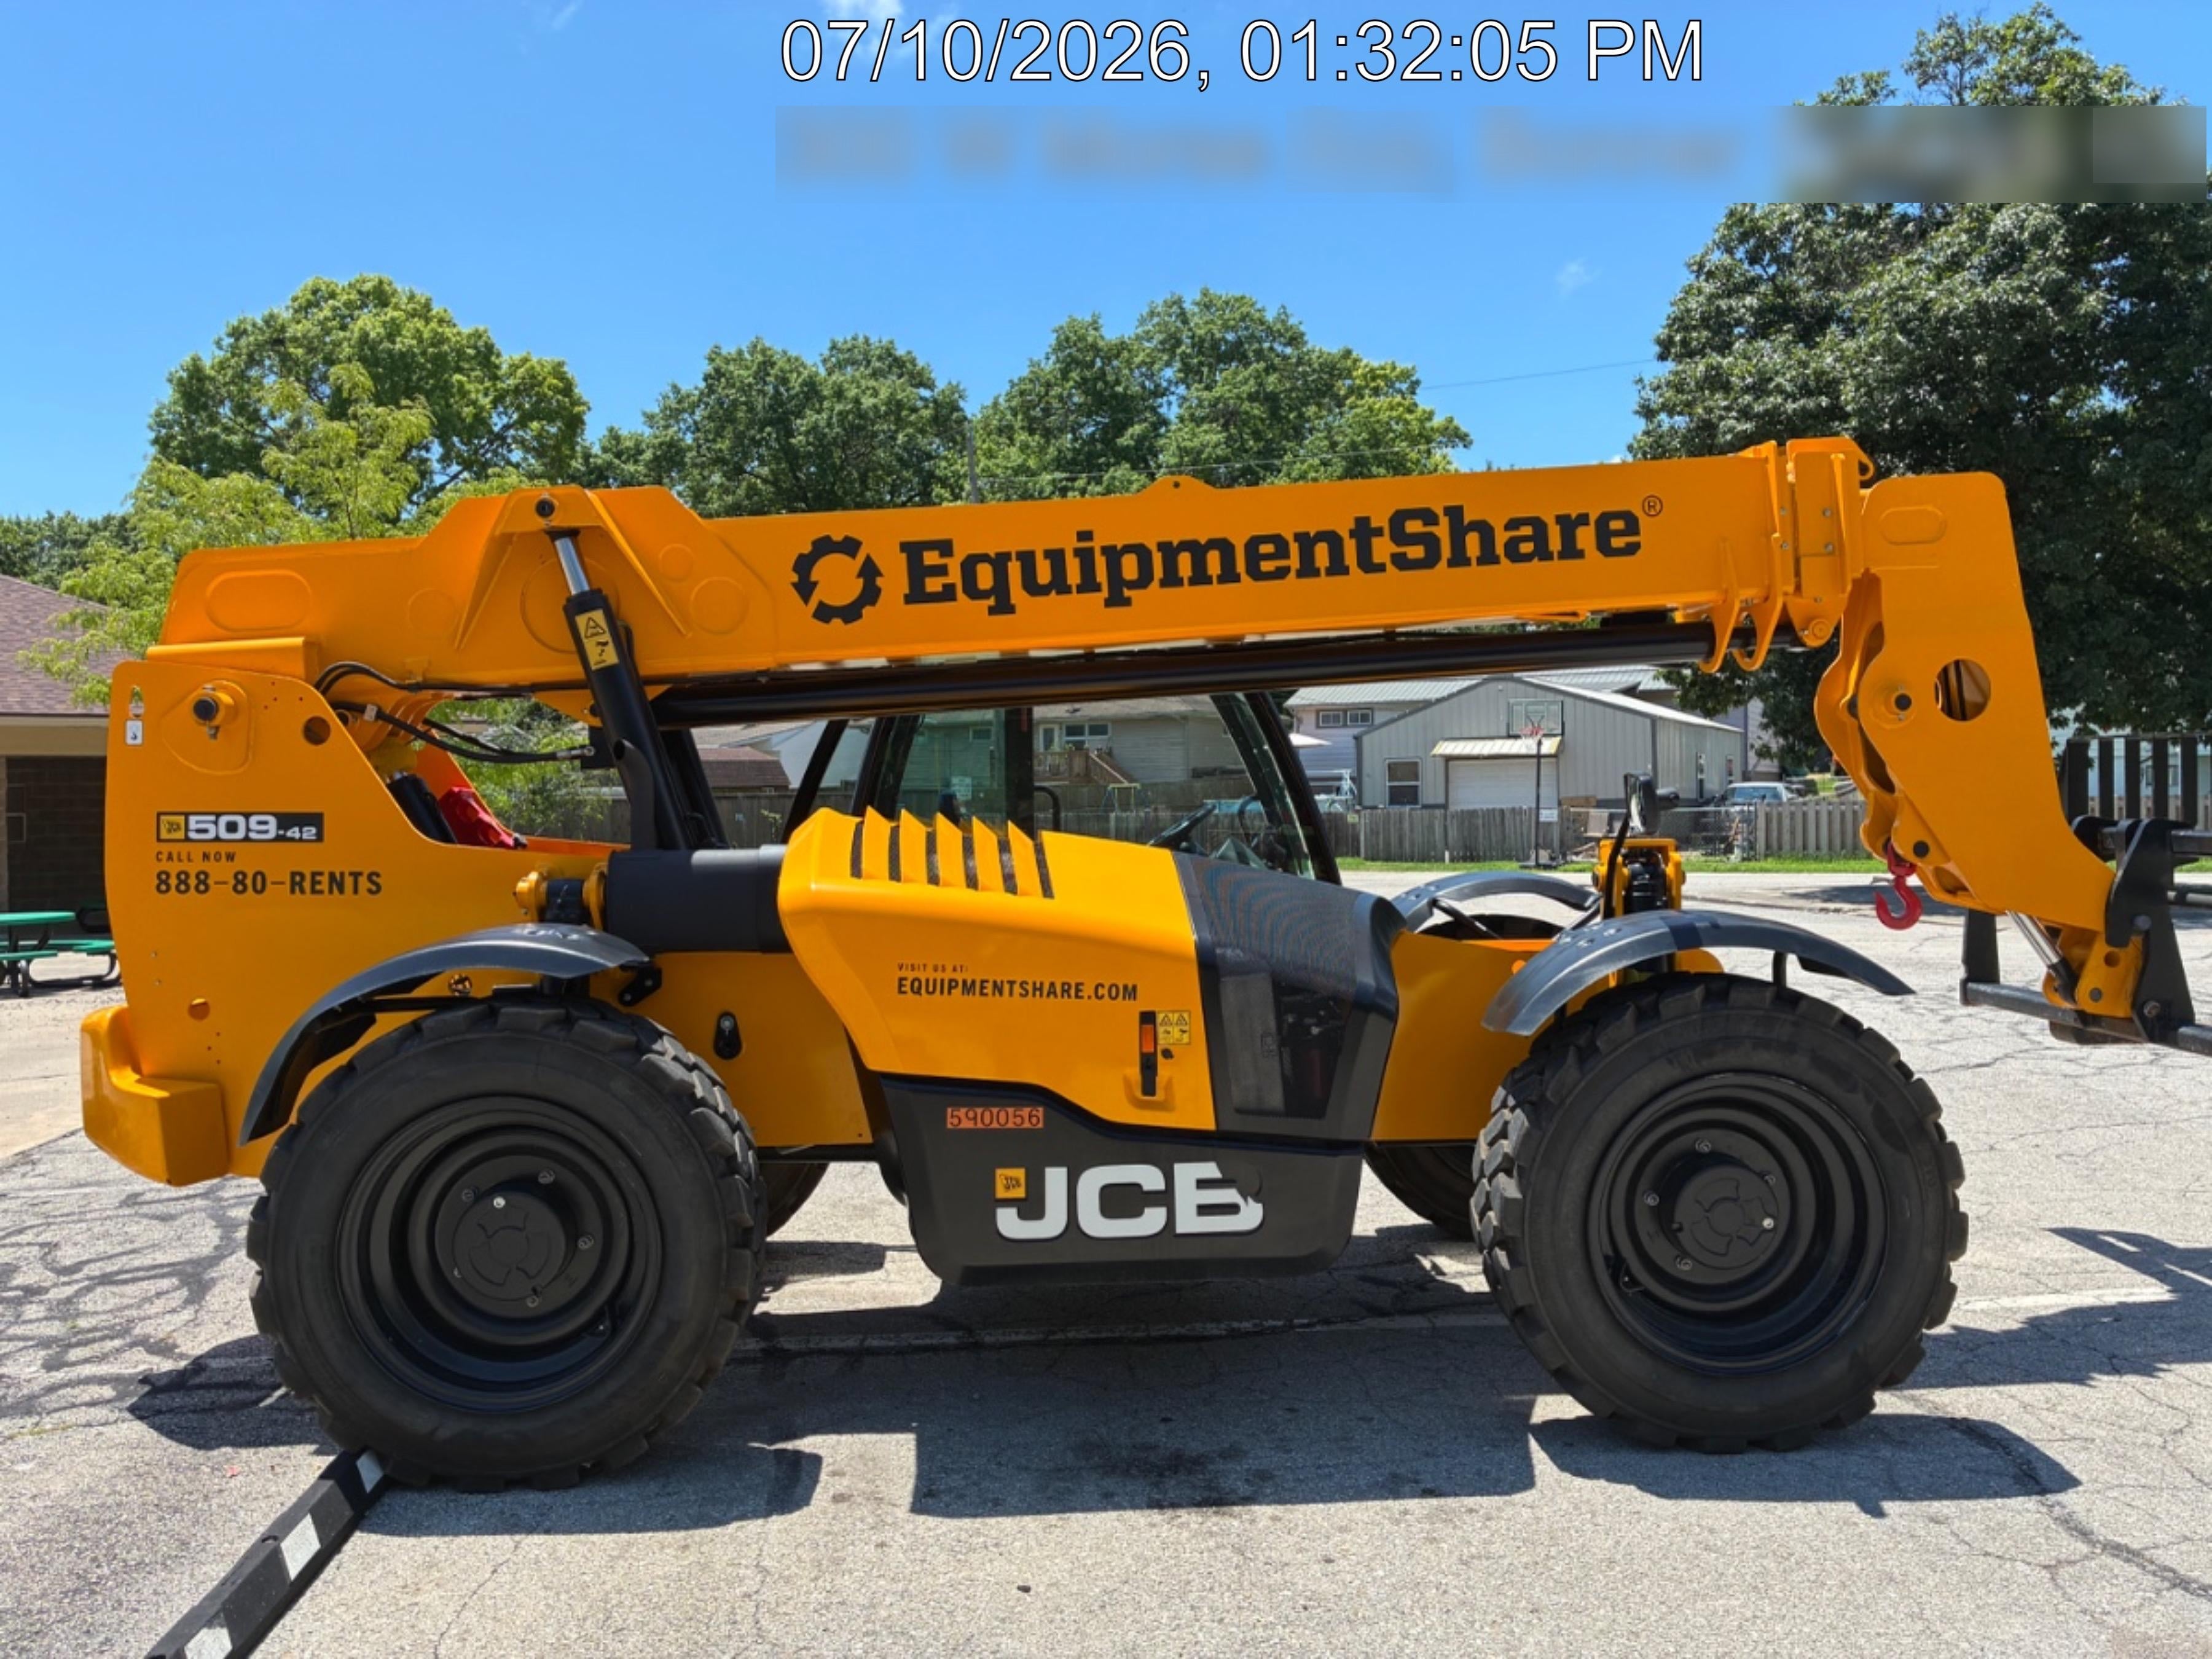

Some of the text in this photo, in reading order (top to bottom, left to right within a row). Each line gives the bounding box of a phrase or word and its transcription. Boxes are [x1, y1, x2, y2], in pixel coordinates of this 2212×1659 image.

[187, 814, 316, 840] 509-42
[155, 851, 237, 863] CALL NOW
[155, 869, 382, 895] 888-80-RENTS
[898, 963, 927, 972] VISIT
[932, 963, 946, 973] US
[897, 976, 1138, 1002] EQUIPMENTSHARE.COM
[949, 1108, 1041, 1126] 590056
[996, 1161, 1264, 1239] JCB
